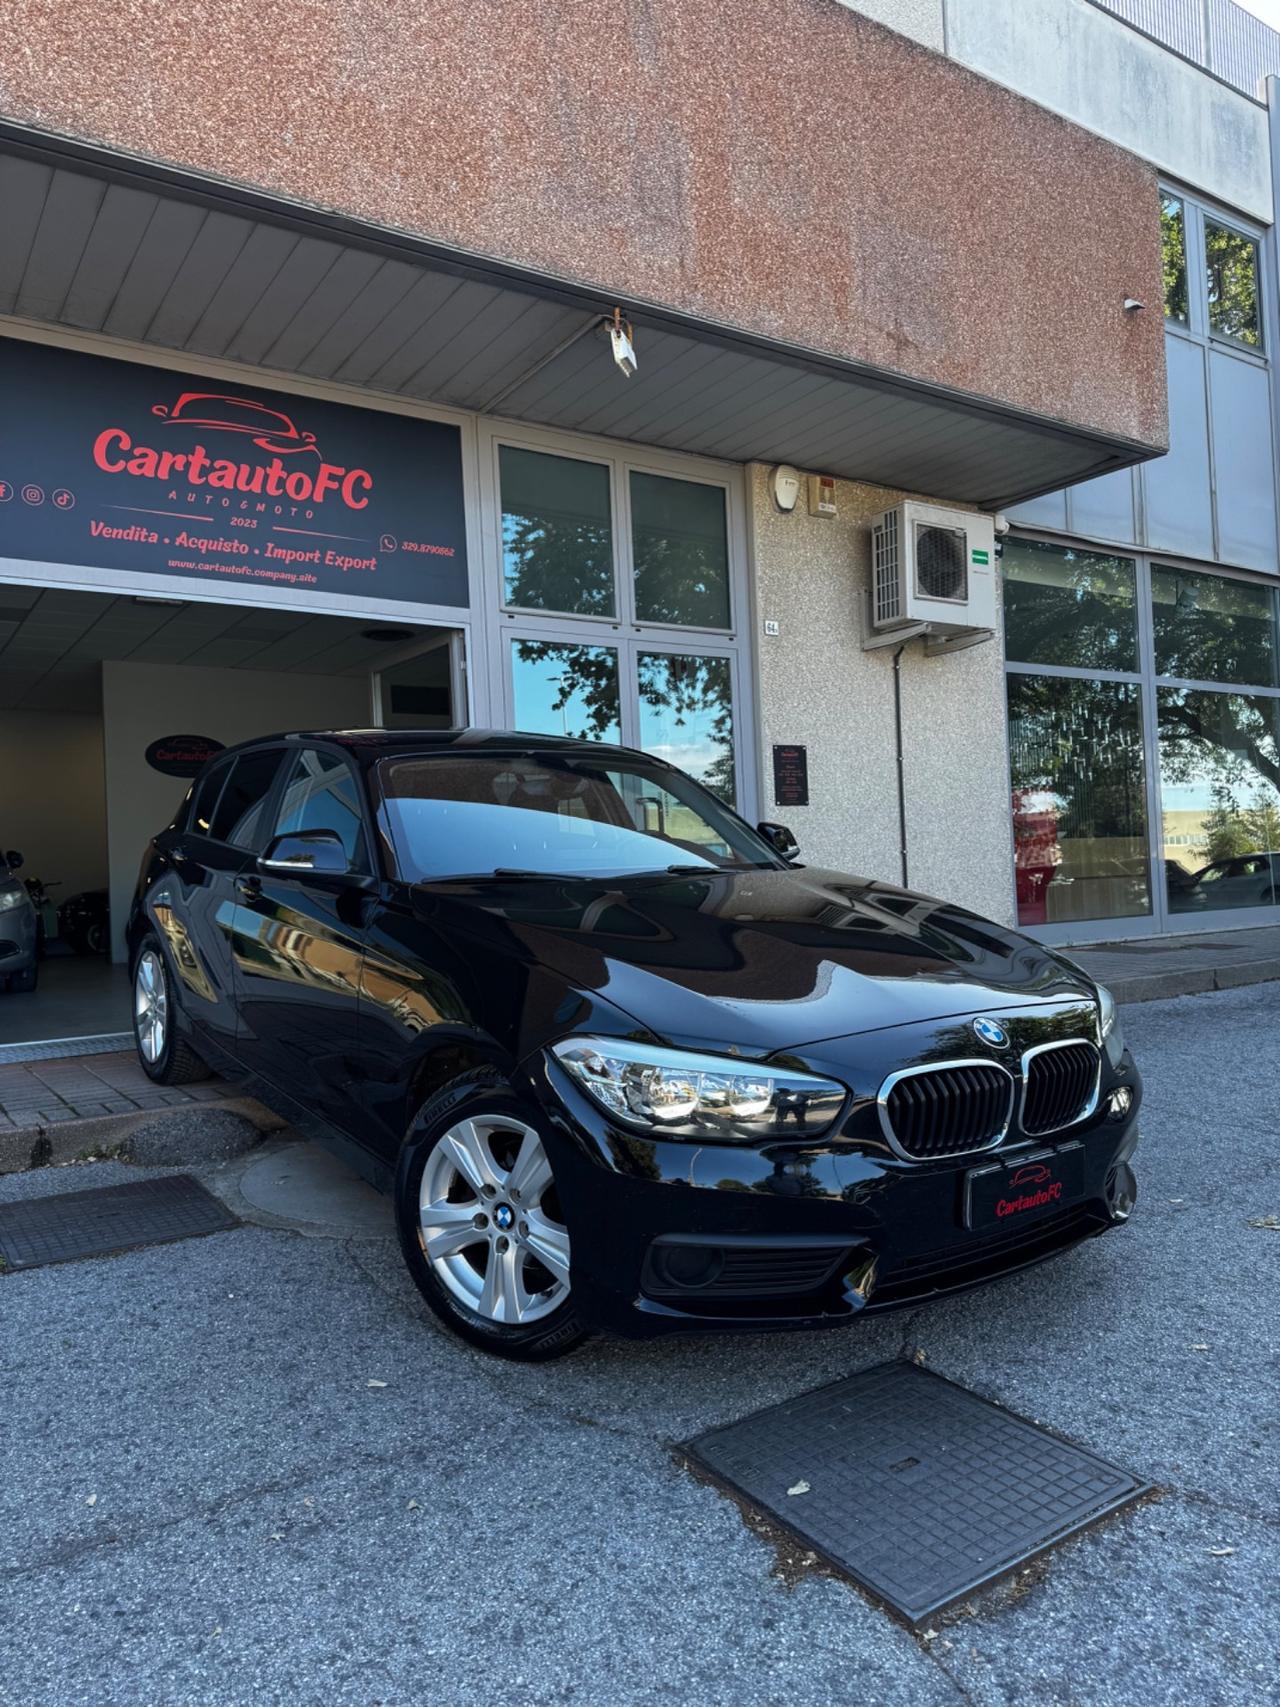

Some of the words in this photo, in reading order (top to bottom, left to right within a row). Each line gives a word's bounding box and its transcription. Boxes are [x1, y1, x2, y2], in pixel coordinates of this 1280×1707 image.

[93, 428, 373, 509] CartautoFC
[230, 516, 258, 529] 2023
[89, 520, 158, 544] Vendita
[175, 531, 249, 554] Acquisto
[264, 542, 320, 564] Import
[325, 550, 377, 571] Export
[168, 559, 318, 584] www.cartautofc.company.site
[996, 1182, 1062, 1216] CartautoFC
